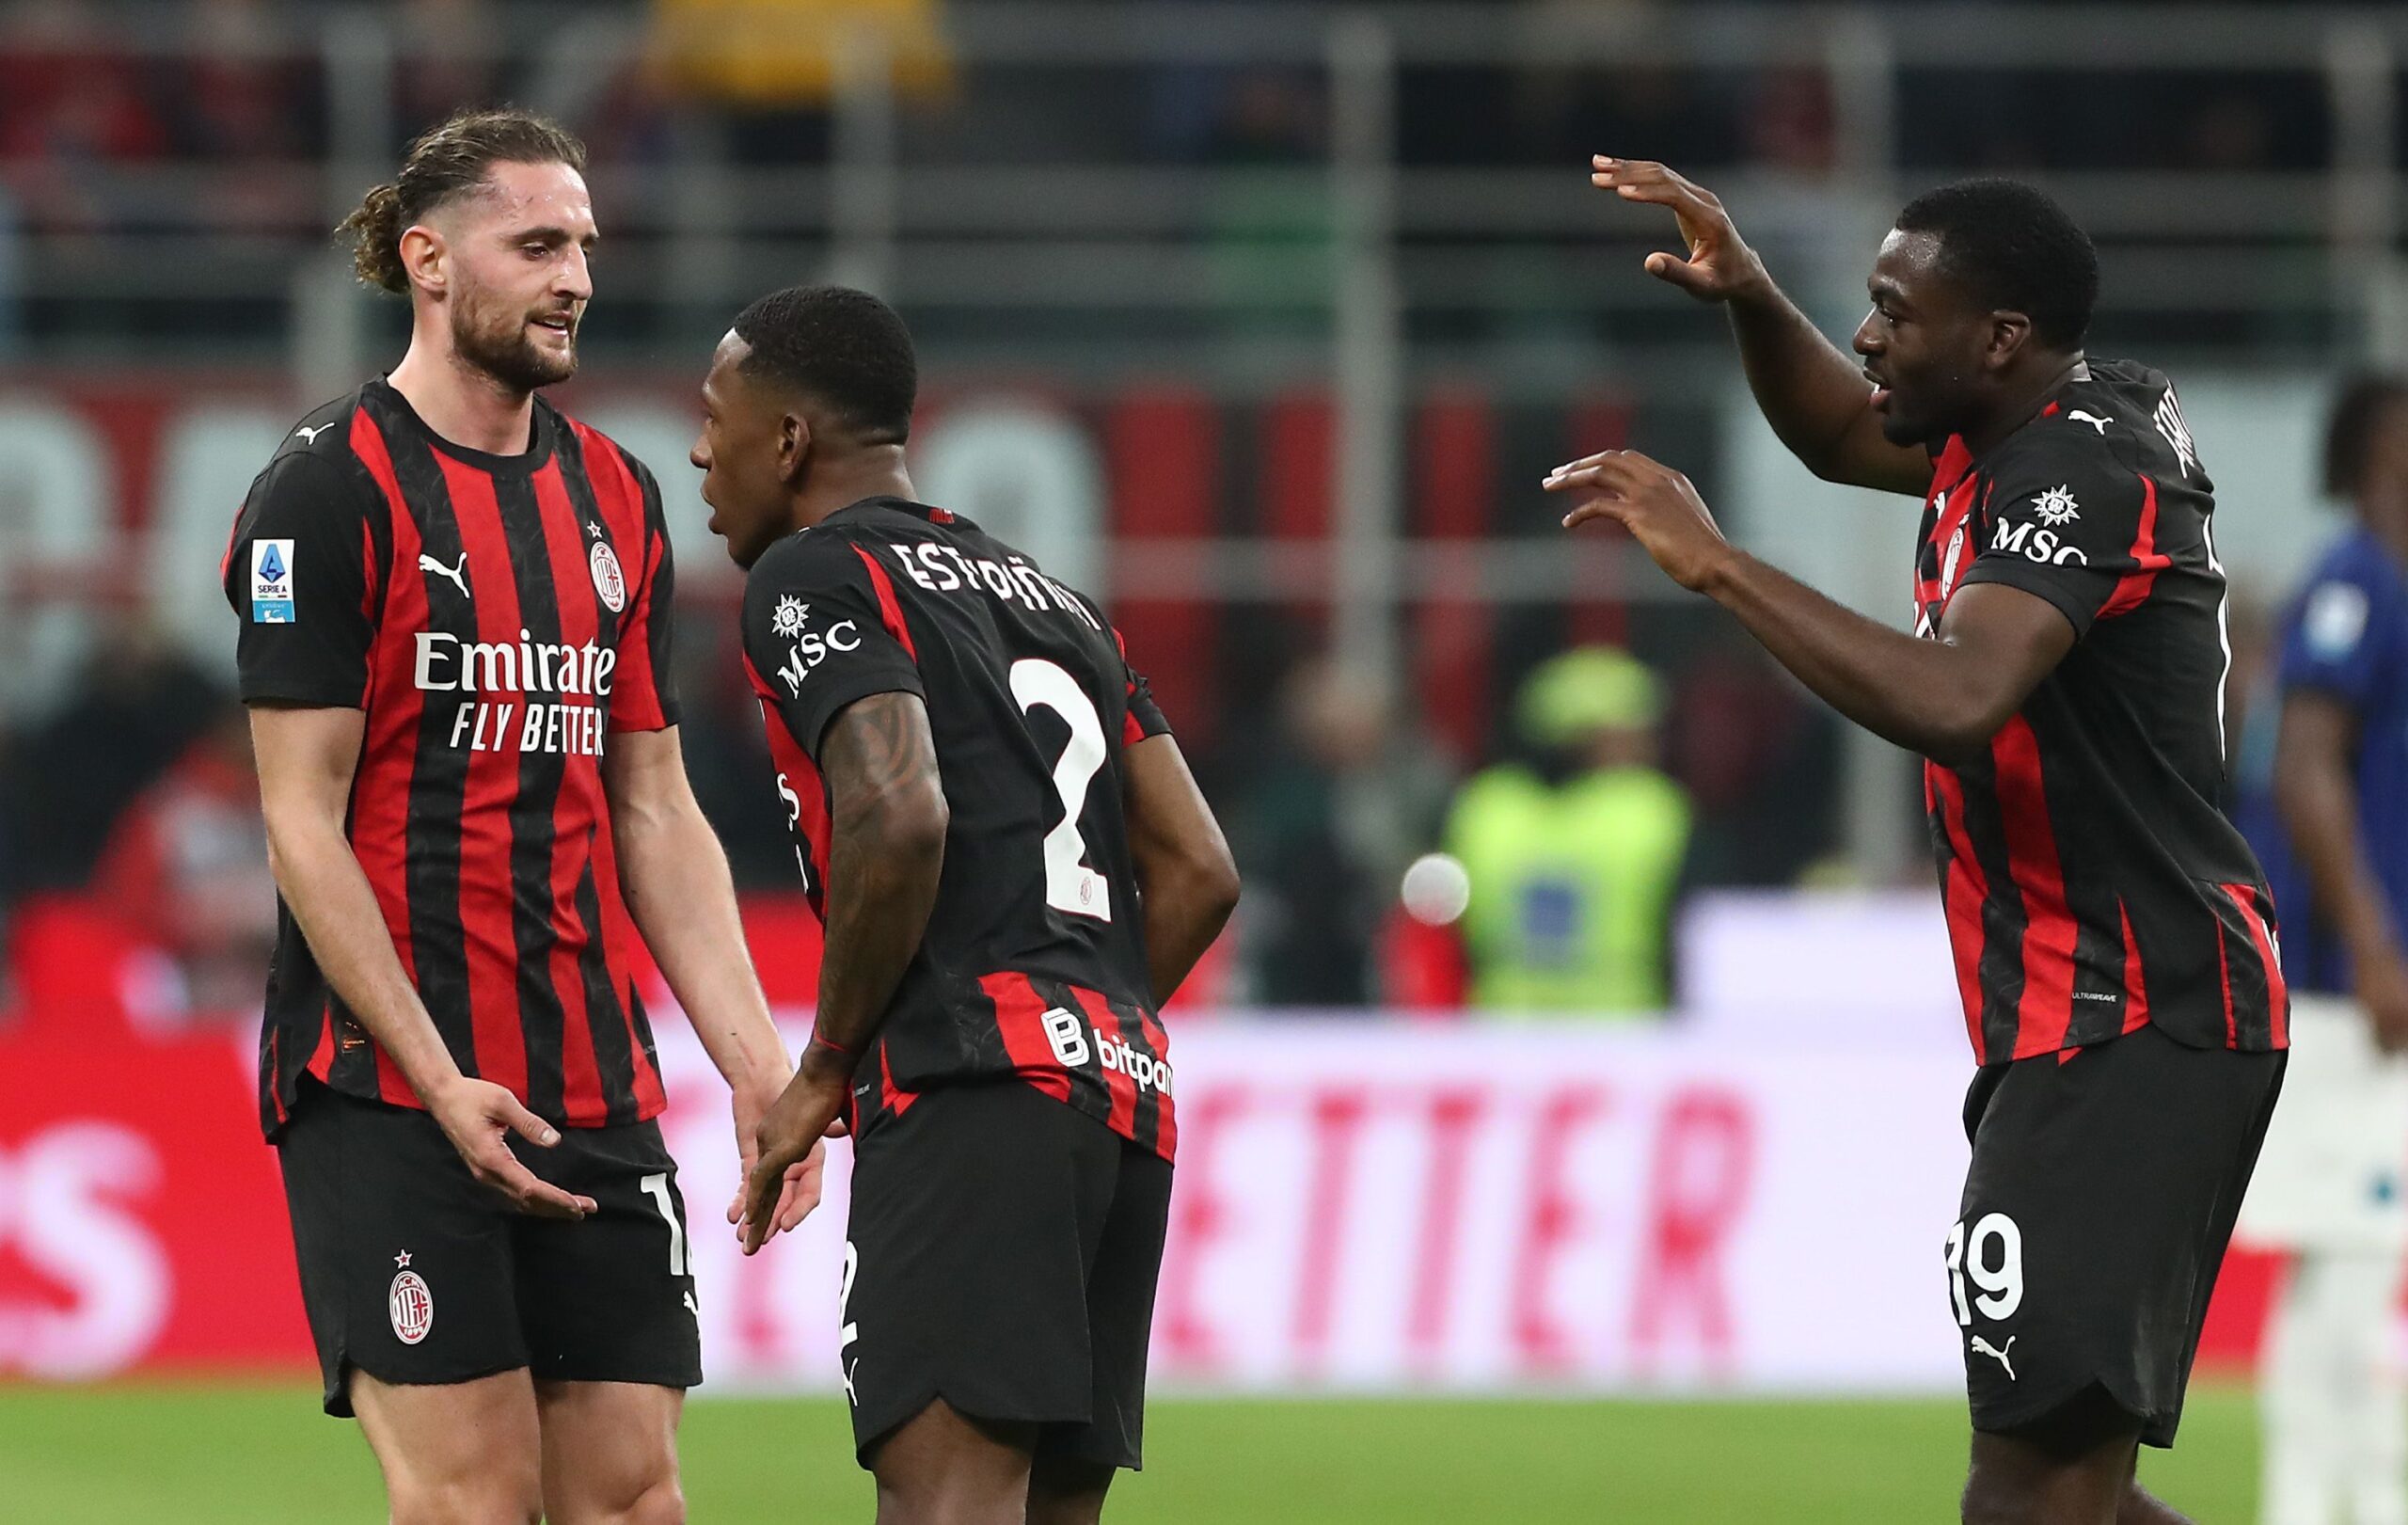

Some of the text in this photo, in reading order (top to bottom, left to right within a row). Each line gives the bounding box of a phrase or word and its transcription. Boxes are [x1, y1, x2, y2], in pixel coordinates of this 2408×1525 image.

[258, 585, 279, 594] SERIE
[414, 628, 616, 696] Emirate
[777, 619, 862, 699] MSC
[450, 702, 604, 756] FLY BETTER
[1009, 659, 1112, 922] 2
[1093, 1028, 1174, 1100] bitpan
[641, 1172, 692, 1276] 1
[1152, 1080, 1757, 1378] ETTER
[1944, 1212, 2024, 1325] 19
